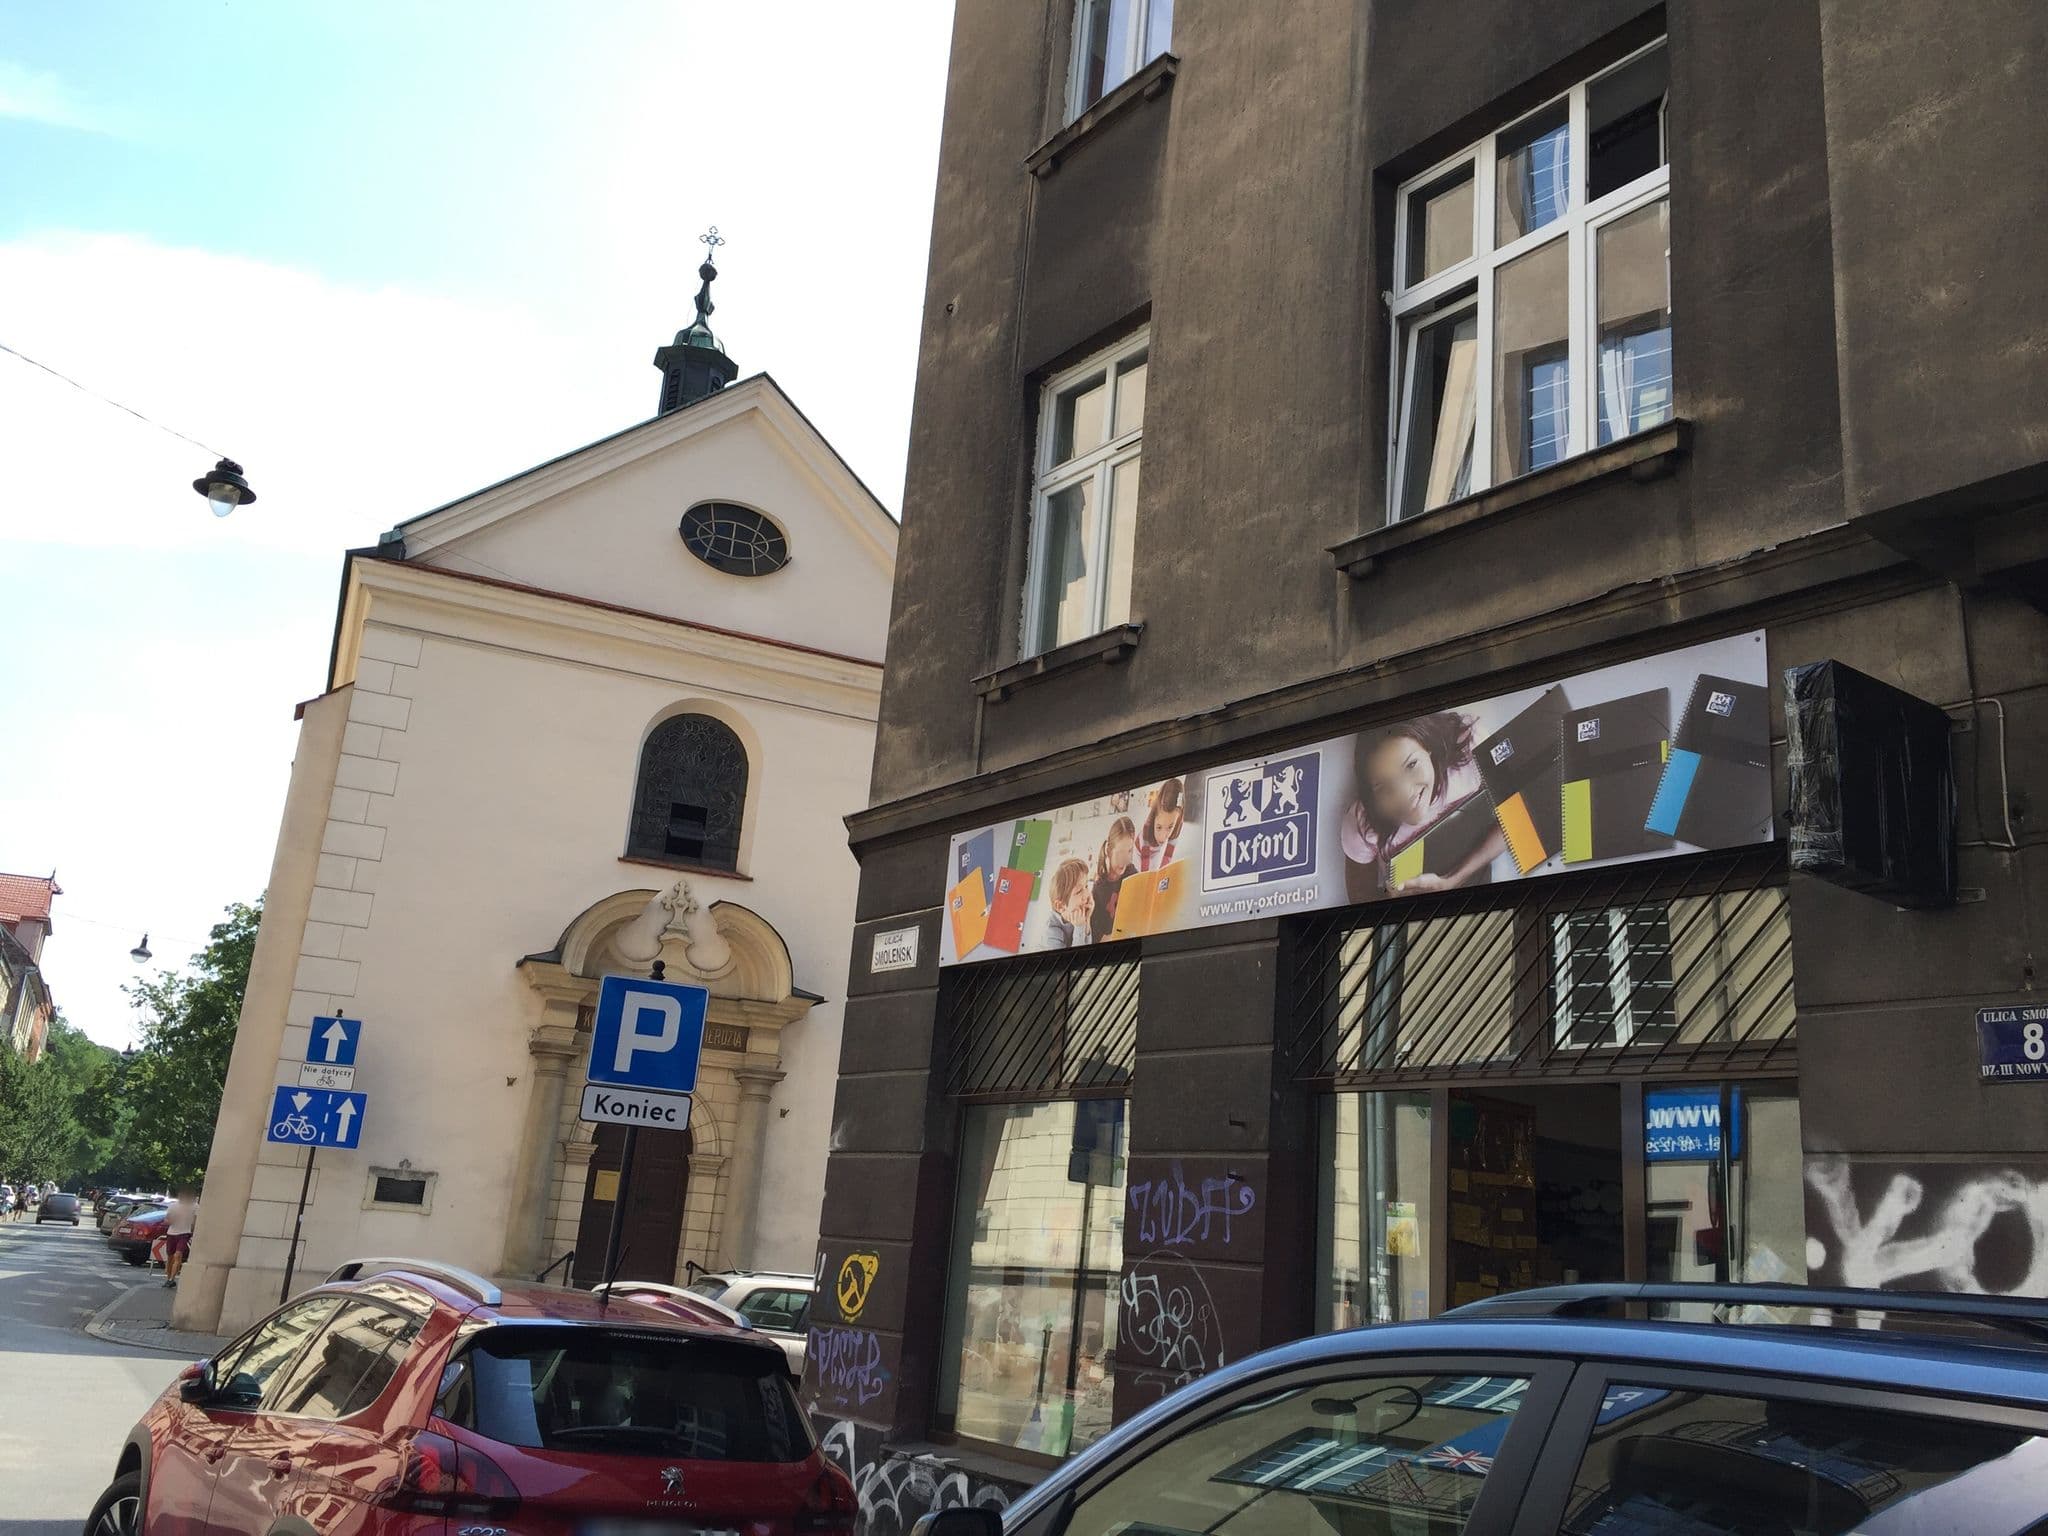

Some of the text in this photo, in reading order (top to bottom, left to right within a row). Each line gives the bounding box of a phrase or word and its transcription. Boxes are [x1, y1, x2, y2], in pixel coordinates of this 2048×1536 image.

[1220, 821, 1299, 874] Oxford
[1199, 885, 1318, 917] www.my-oxford.pl
[1983, 1008, 2048, 1022] ULICA SMO
[613, 990, 682, 1073] P
[2023, 1022, 2045, 1060] 8
[304, 1065, 352, 1078] Nie dotyczy
[2000, 1063, 2014, 1075] III
[593, 1094, 677, 1122] Koniec
